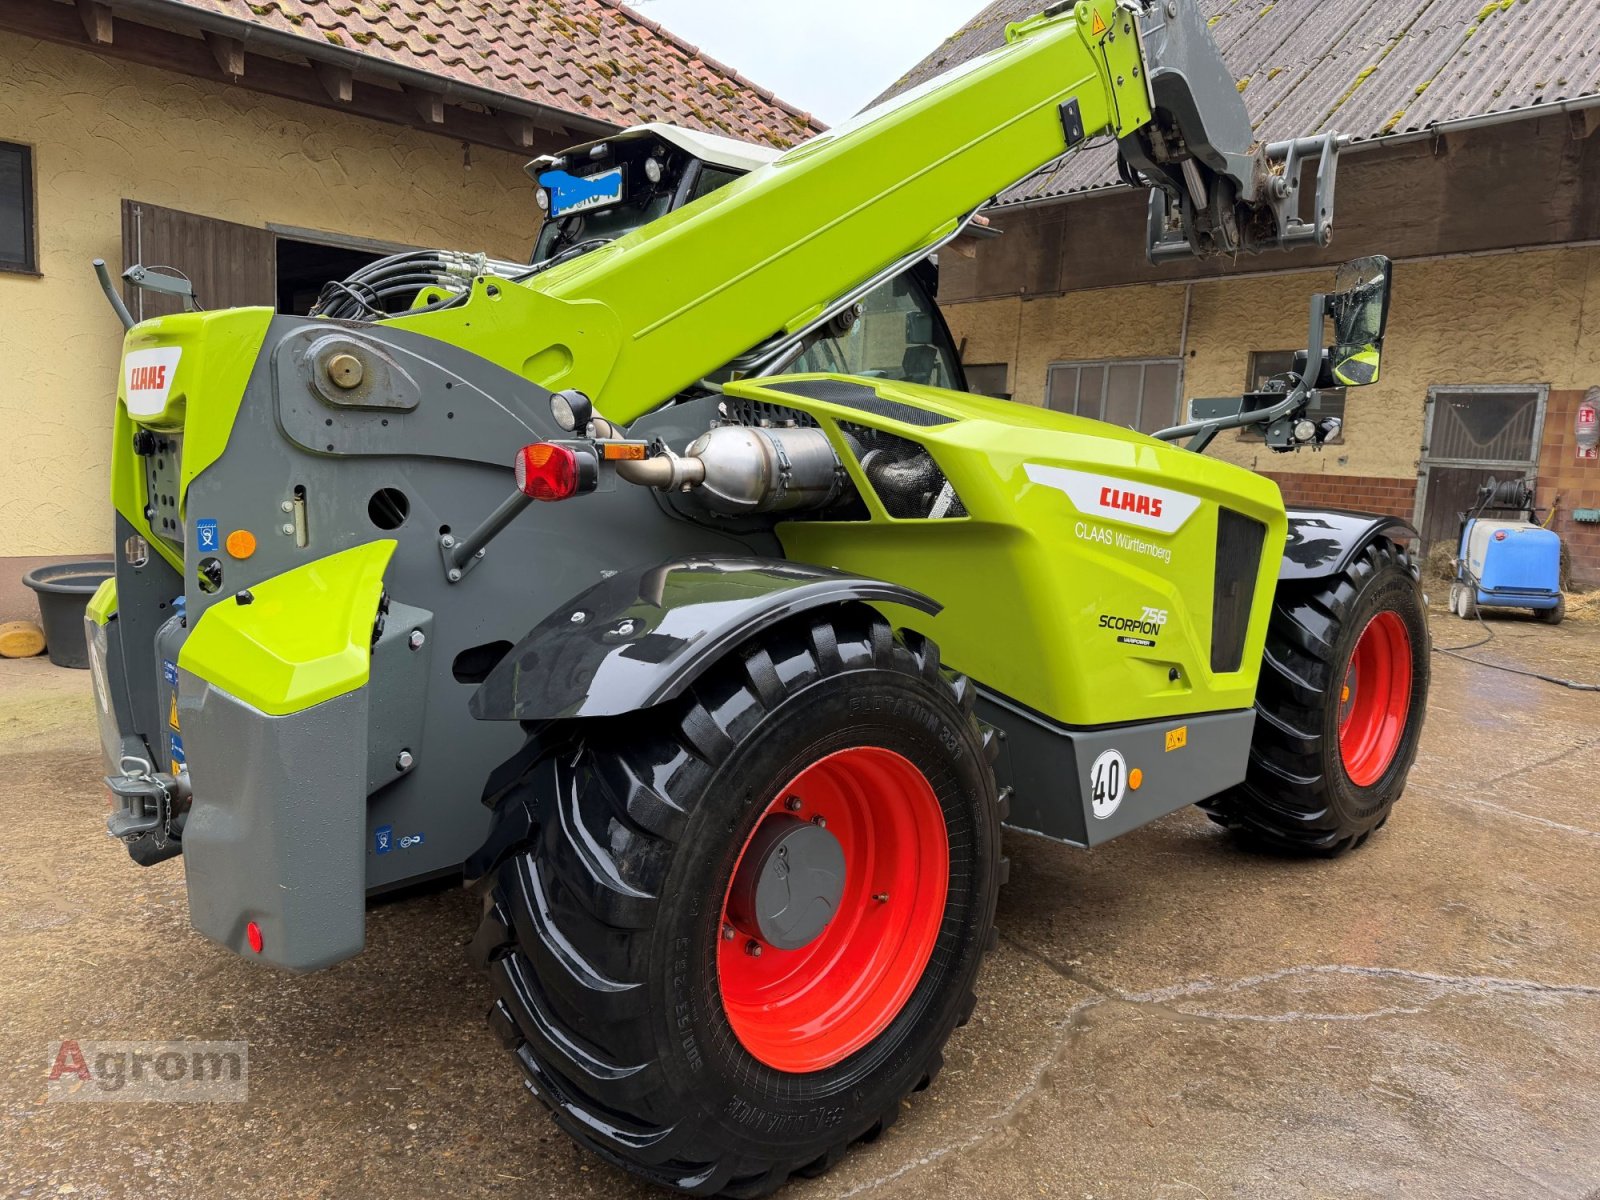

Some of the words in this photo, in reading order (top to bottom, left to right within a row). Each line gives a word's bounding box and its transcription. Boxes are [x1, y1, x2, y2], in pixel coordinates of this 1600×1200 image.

[130, 365, 166, 391] CLAAS
[1099, 486, 1163, 518] CLAAS
[1075, 521, 1113, 545] CLAAS
[1115, 531, 1171, 564] Württemberg
[1098, 614, 1161, 636] SCORPION
[1139, 606, 1168, 625] 756
[1092, 759, 1119, 805] 40
